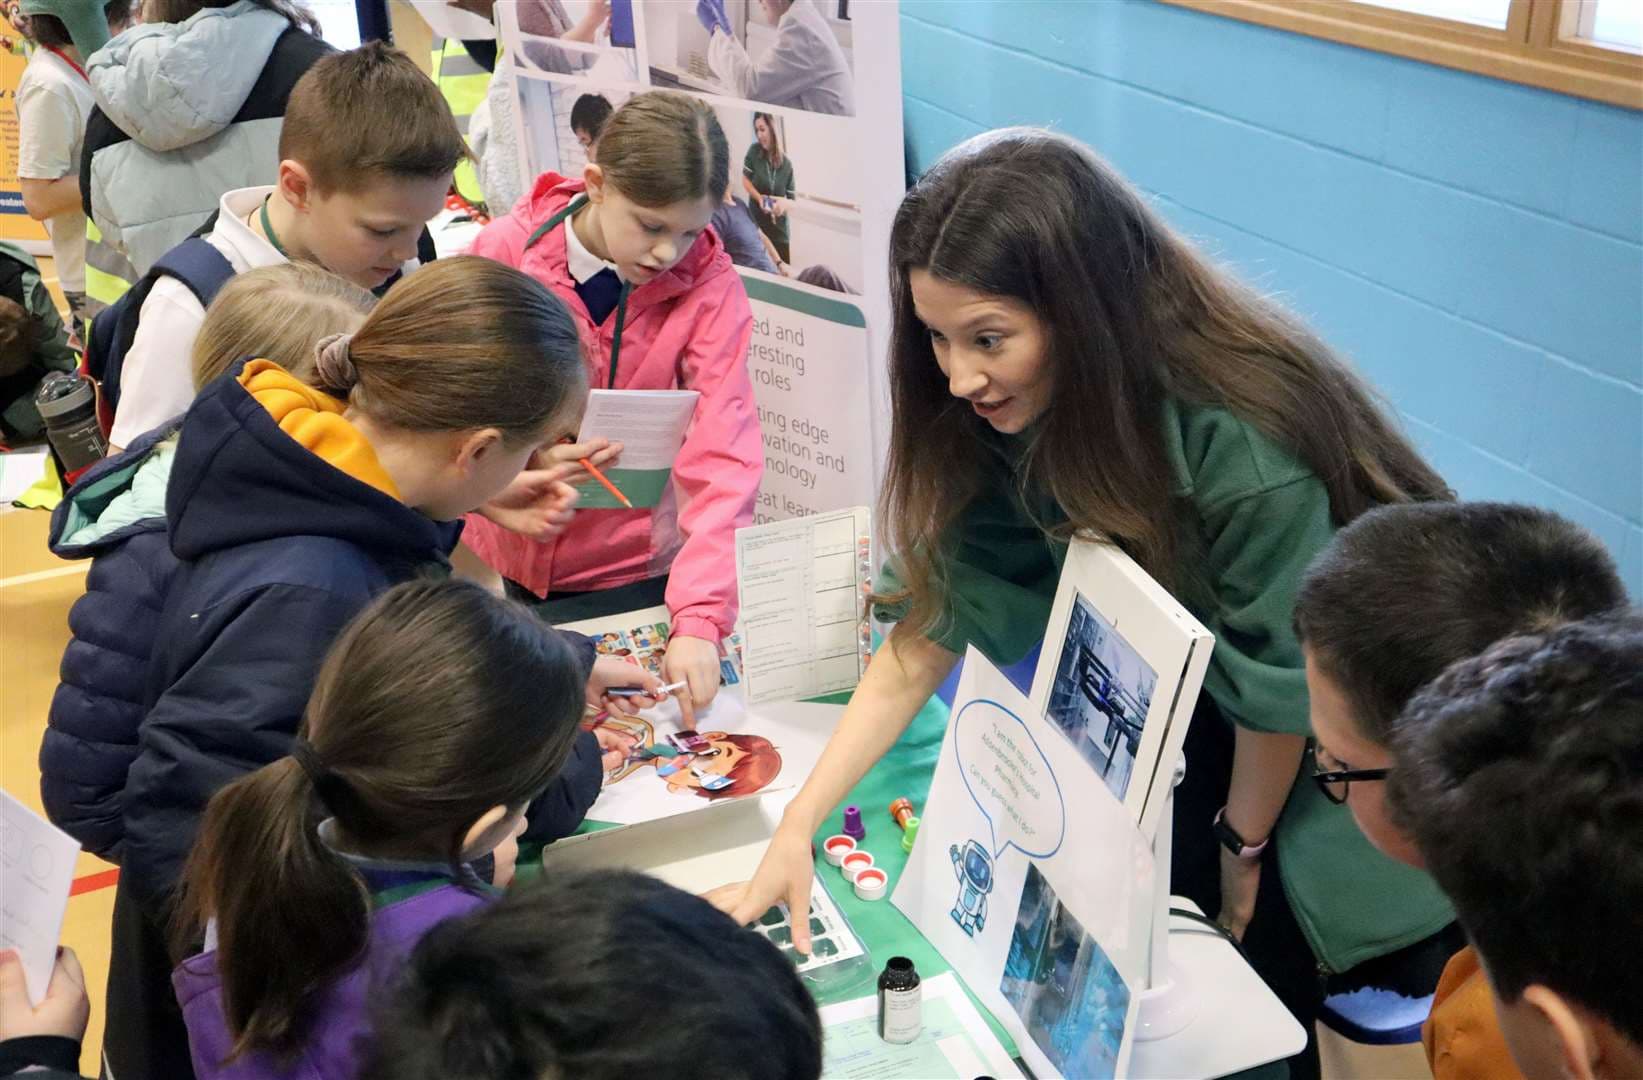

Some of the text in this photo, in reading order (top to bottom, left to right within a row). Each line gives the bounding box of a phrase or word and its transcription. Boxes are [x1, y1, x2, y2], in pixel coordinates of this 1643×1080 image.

[775, 325, 805, 347] and
[755, 367, 792, 392] roles
[791, 418, 830, 445] edge
[761, 432, 845, 473] vation and
[765, 456, 817, 489] nology
